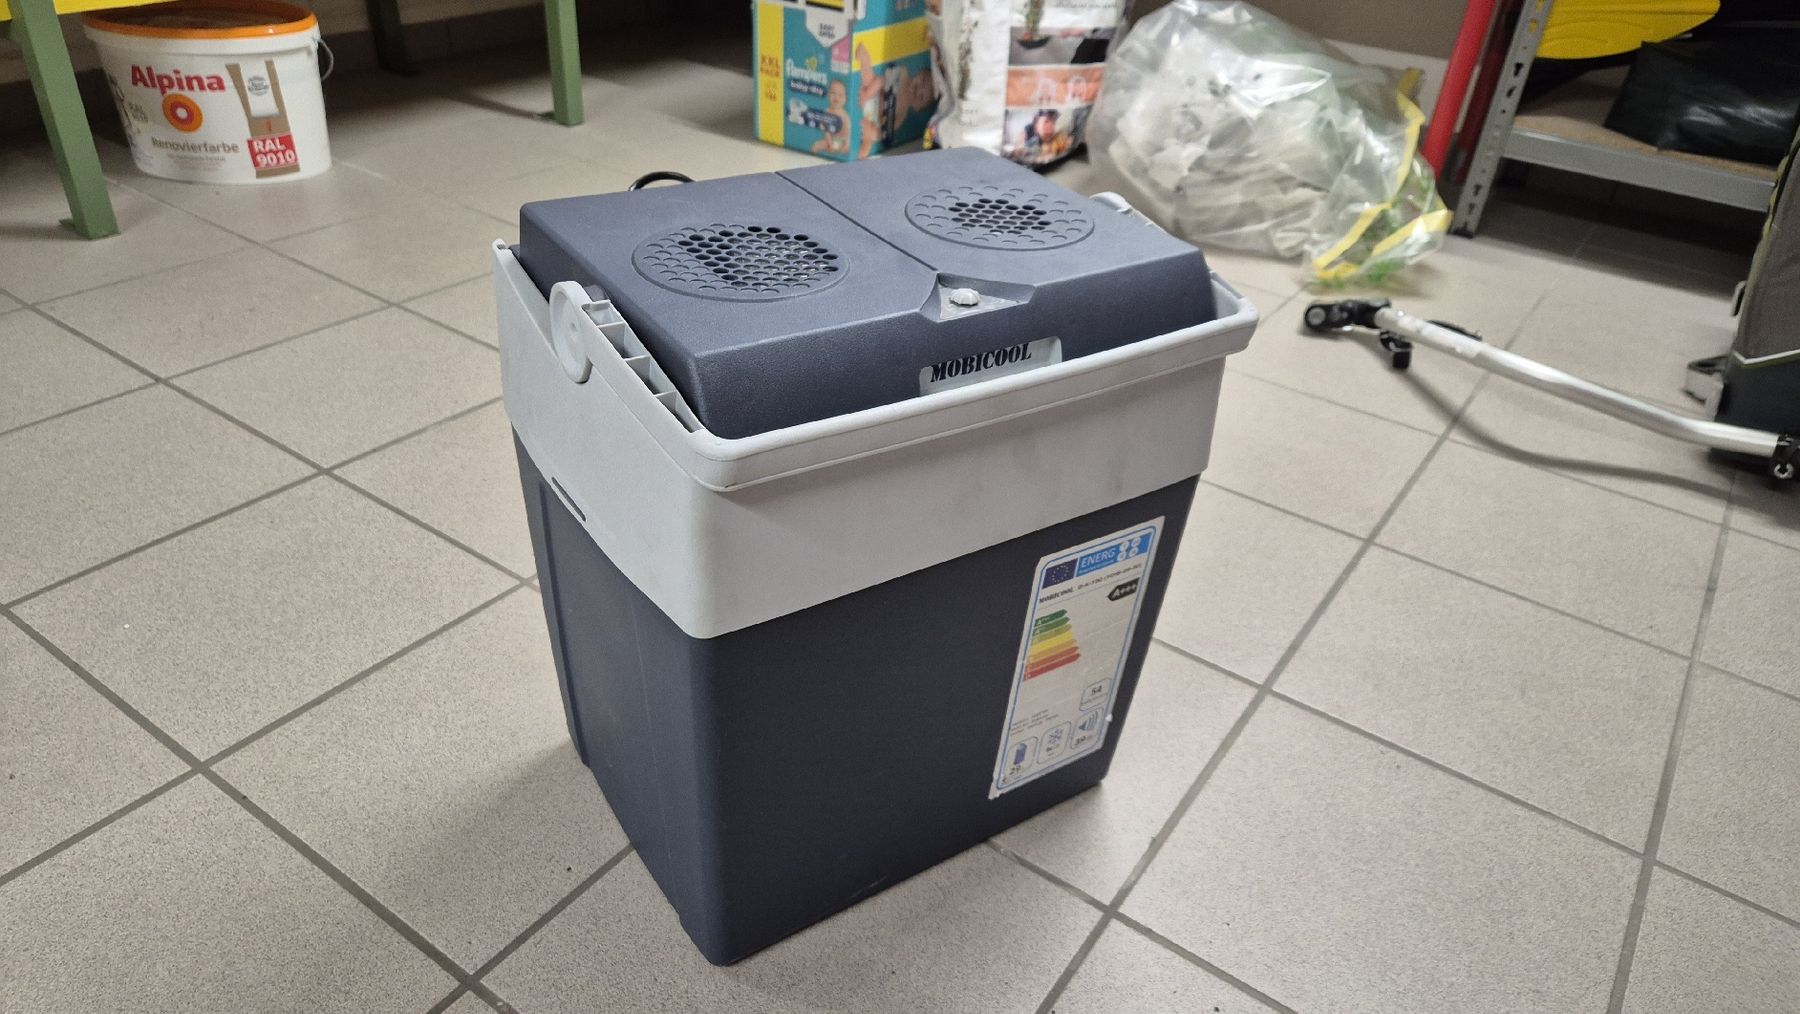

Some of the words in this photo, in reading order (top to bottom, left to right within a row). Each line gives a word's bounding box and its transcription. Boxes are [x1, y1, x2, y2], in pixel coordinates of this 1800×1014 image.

[131, 64, 226, 97] Alpina
[786, 58, 828, 85] Pampers
[152, 136, 240, 154] Renovierfarbe
[254, 139, 286, 153] RAL
[256, 152, 296, 167] 9010
[930, 342, 1032, 383] MOBICOOL
[1080, 548, 1117, 569] ENERG
